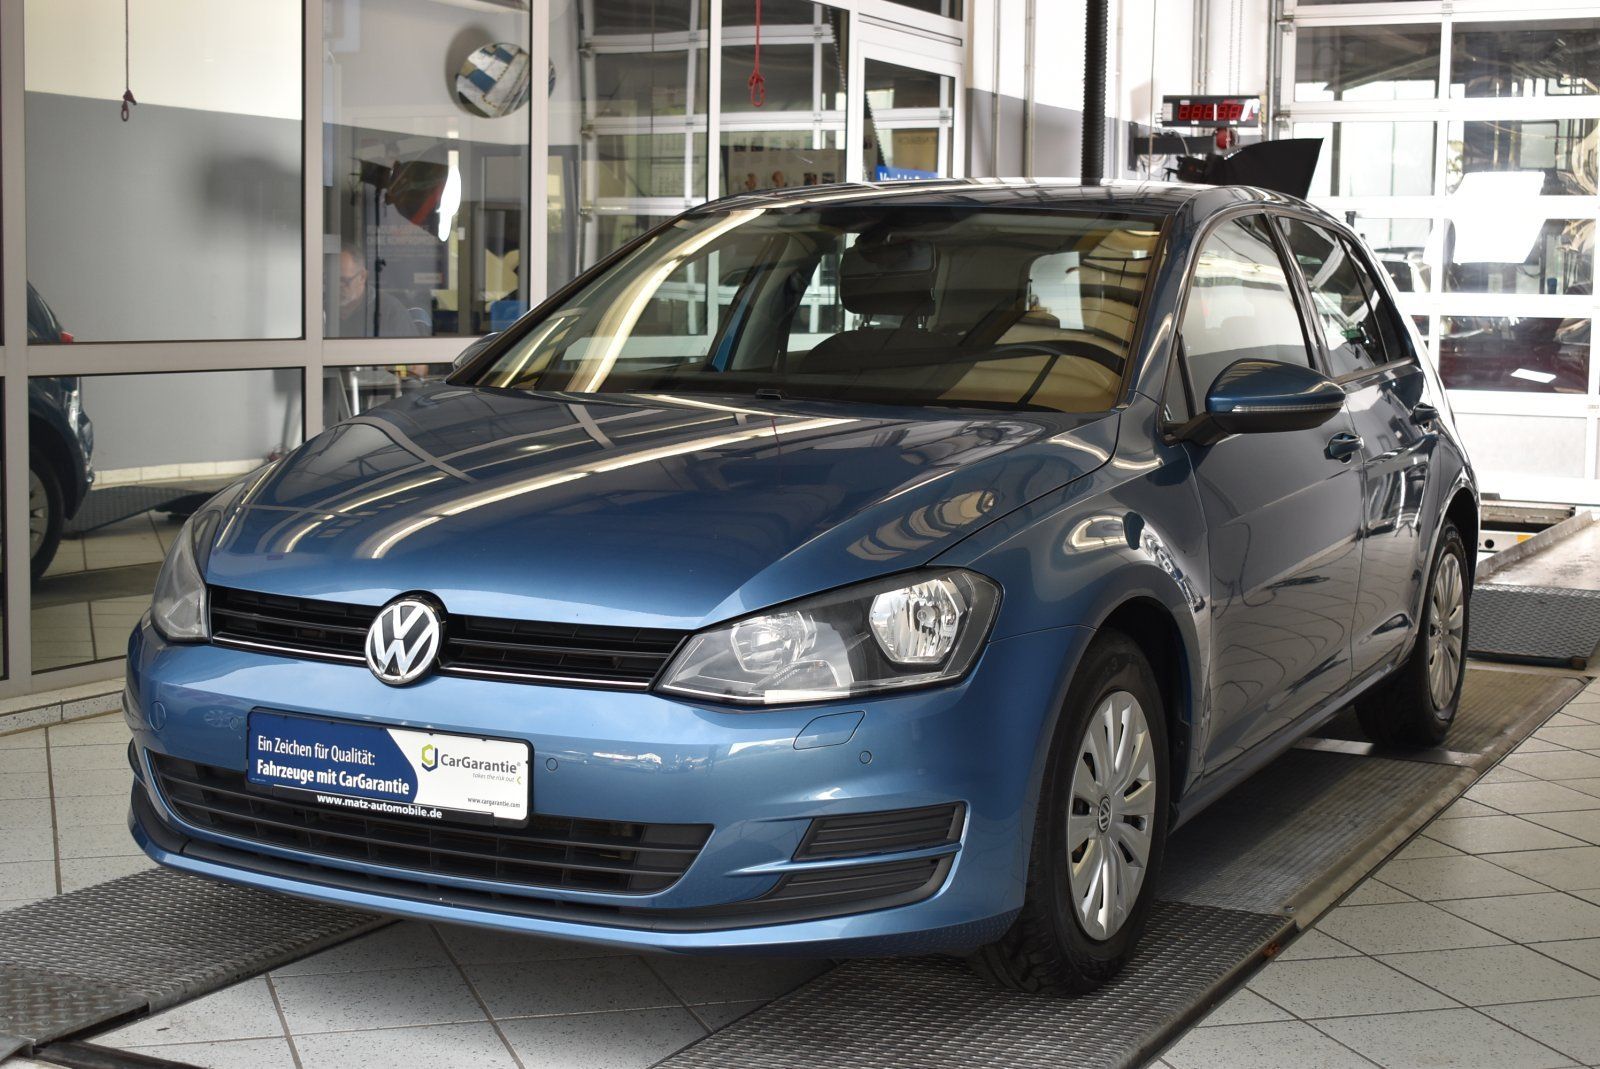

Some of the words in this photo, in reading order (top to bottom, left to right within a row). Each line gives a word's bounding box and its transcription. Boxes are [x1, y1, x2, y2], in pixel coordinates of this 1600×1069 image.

[366, 602, 438, 677] VW
[258, 735, 273, 752] Ein
[274, 737, 312, 757] Zeichen
[314, 742, 329, 759] für
[331, 745, 376, 766] Qualität:
[440, 753, 517, 774] CarGarantie
[257, 759, 315, 784] Fahrzeuge
[316, 769, 337, 785] mit
[339, 771, 410, 795] CarGarantie
[317, 794, 443, 819] www.matz-automobile.de
[467, 797, 521, 809] www.cargarantie.com
